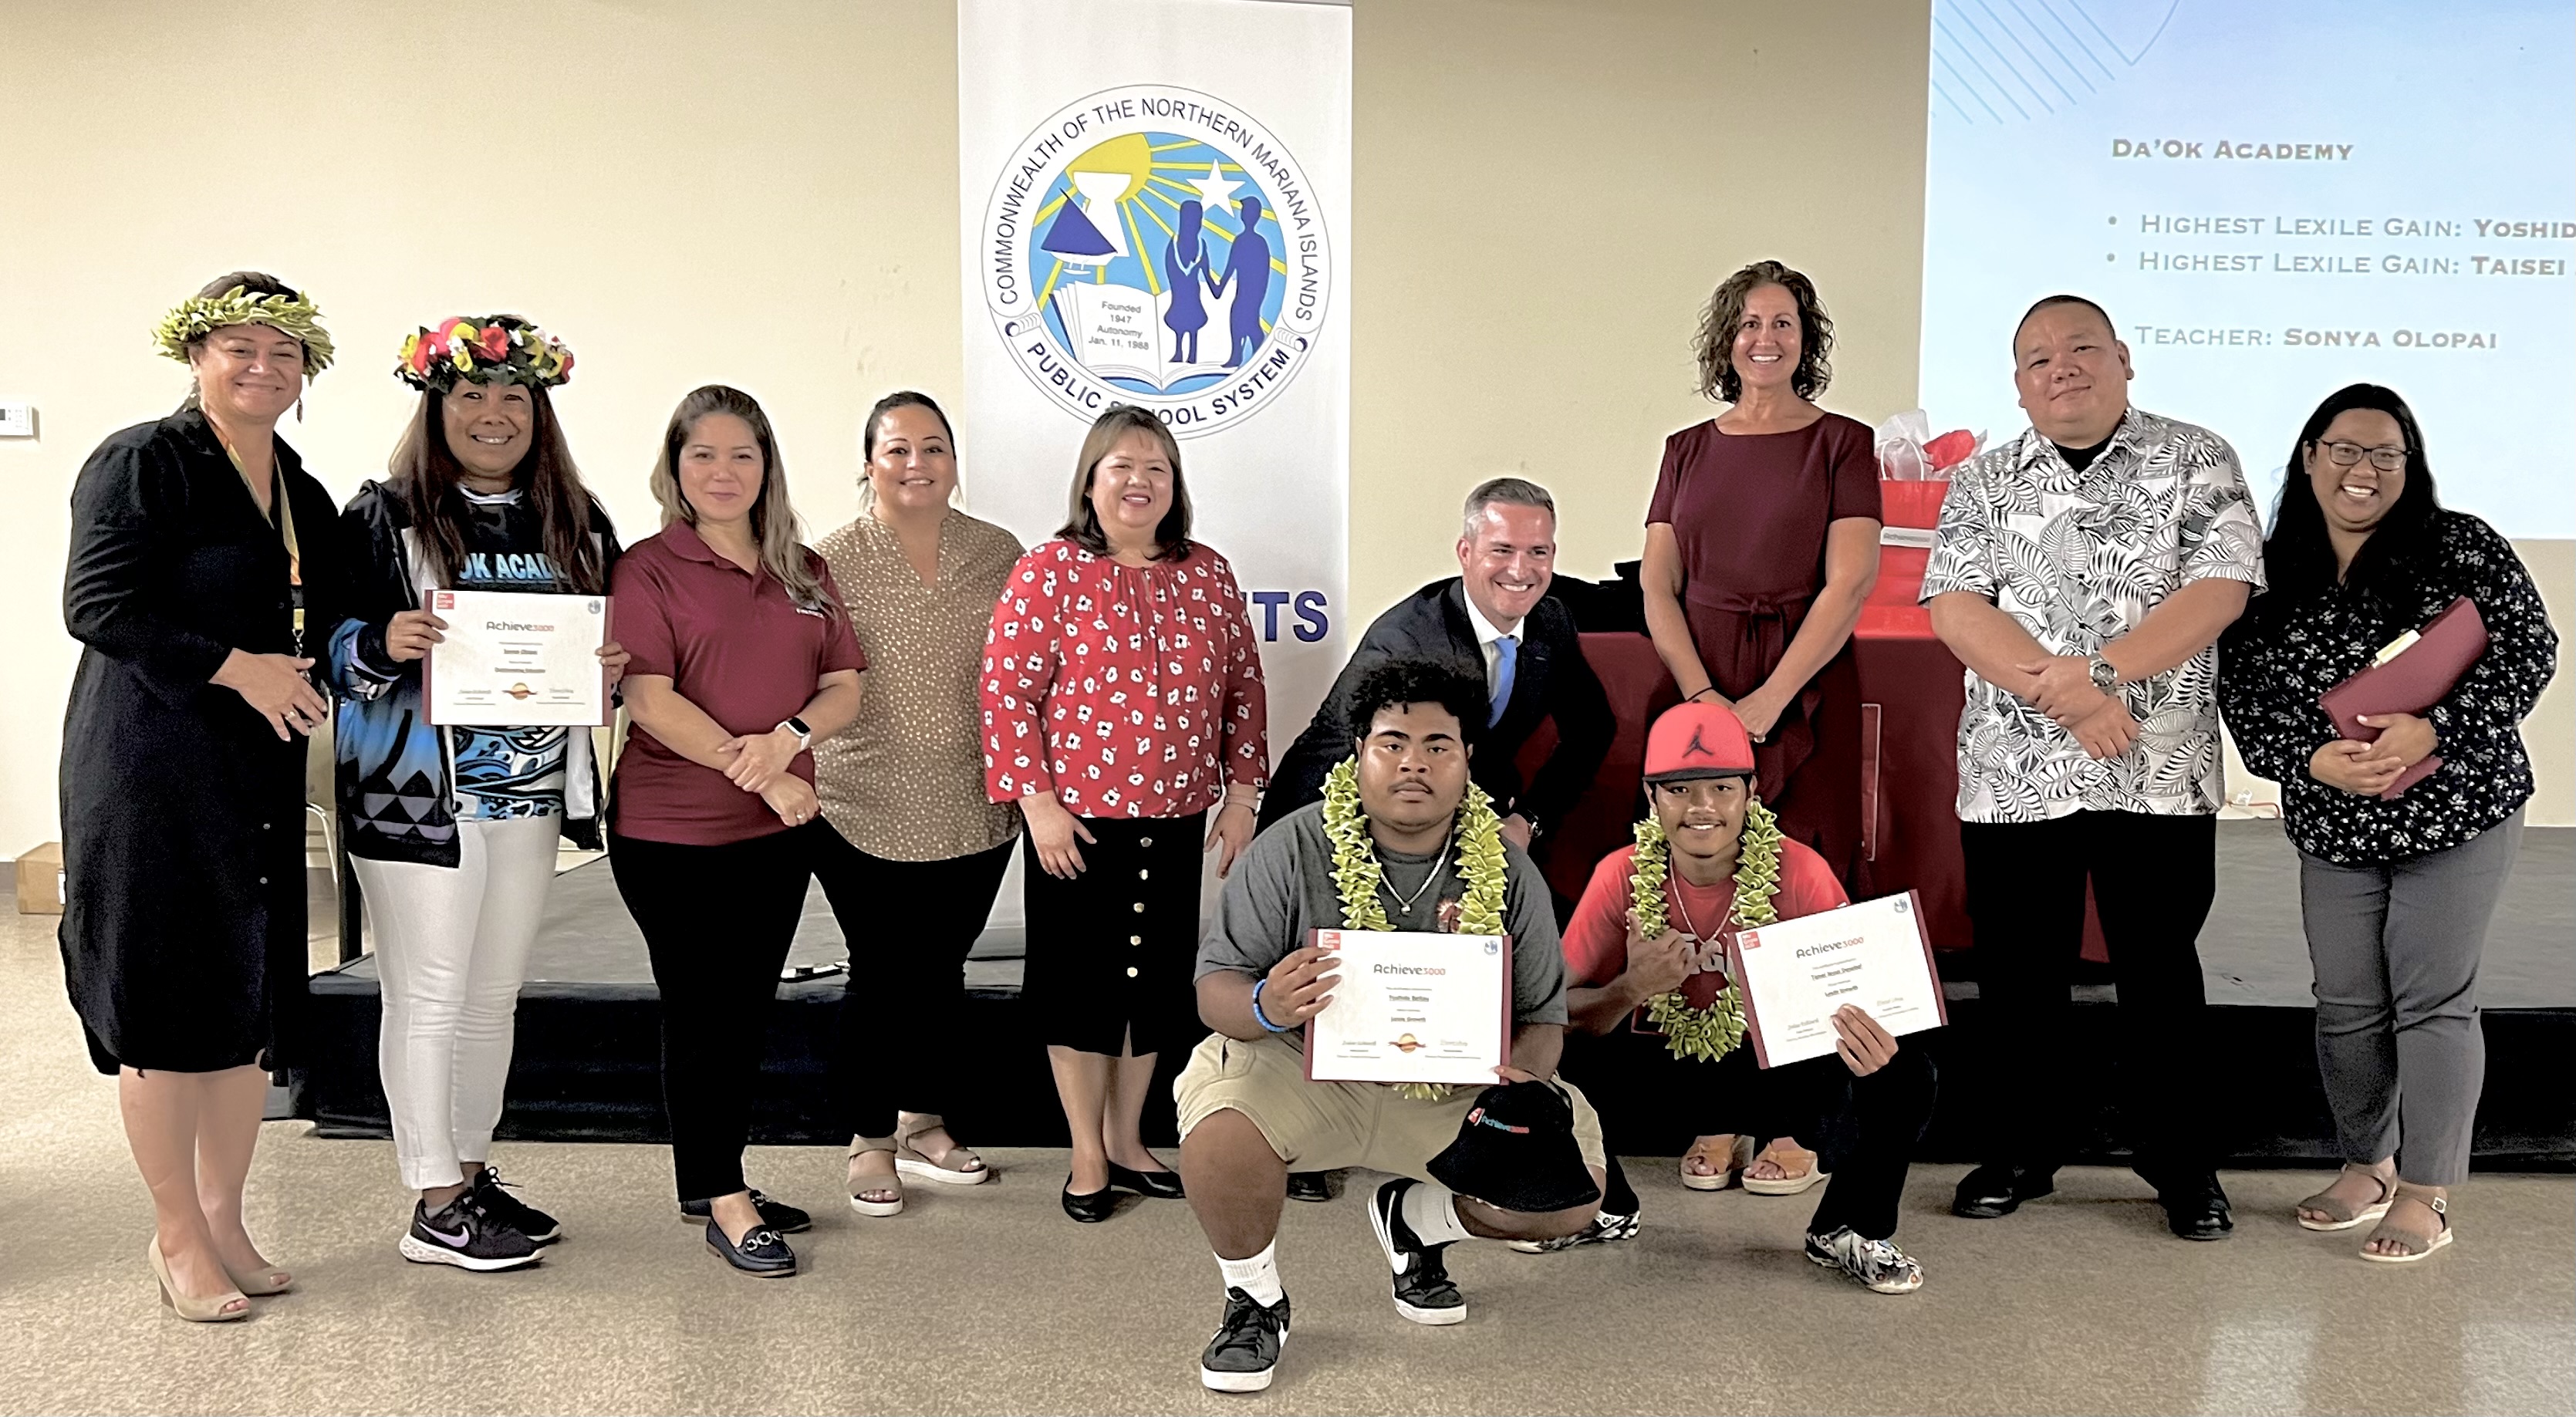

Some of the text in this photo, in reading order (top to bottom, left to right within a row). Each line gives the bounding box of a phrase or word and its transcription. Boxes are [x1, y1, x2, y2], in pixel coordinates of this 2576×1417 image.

[994, 98, 1318, 321] COMMONWEALTH OF THE NORTHERN MARIANA ISLANDS
[1102, 301, 1141, 313] Founded
[1111, 314, 1132, 323] 1947
[1097, 325, 1143, 339] Autonomy
[1027, 342, 1102, 410] PUBLIC
[1212, 348, 1290, 414] SYSTEM
